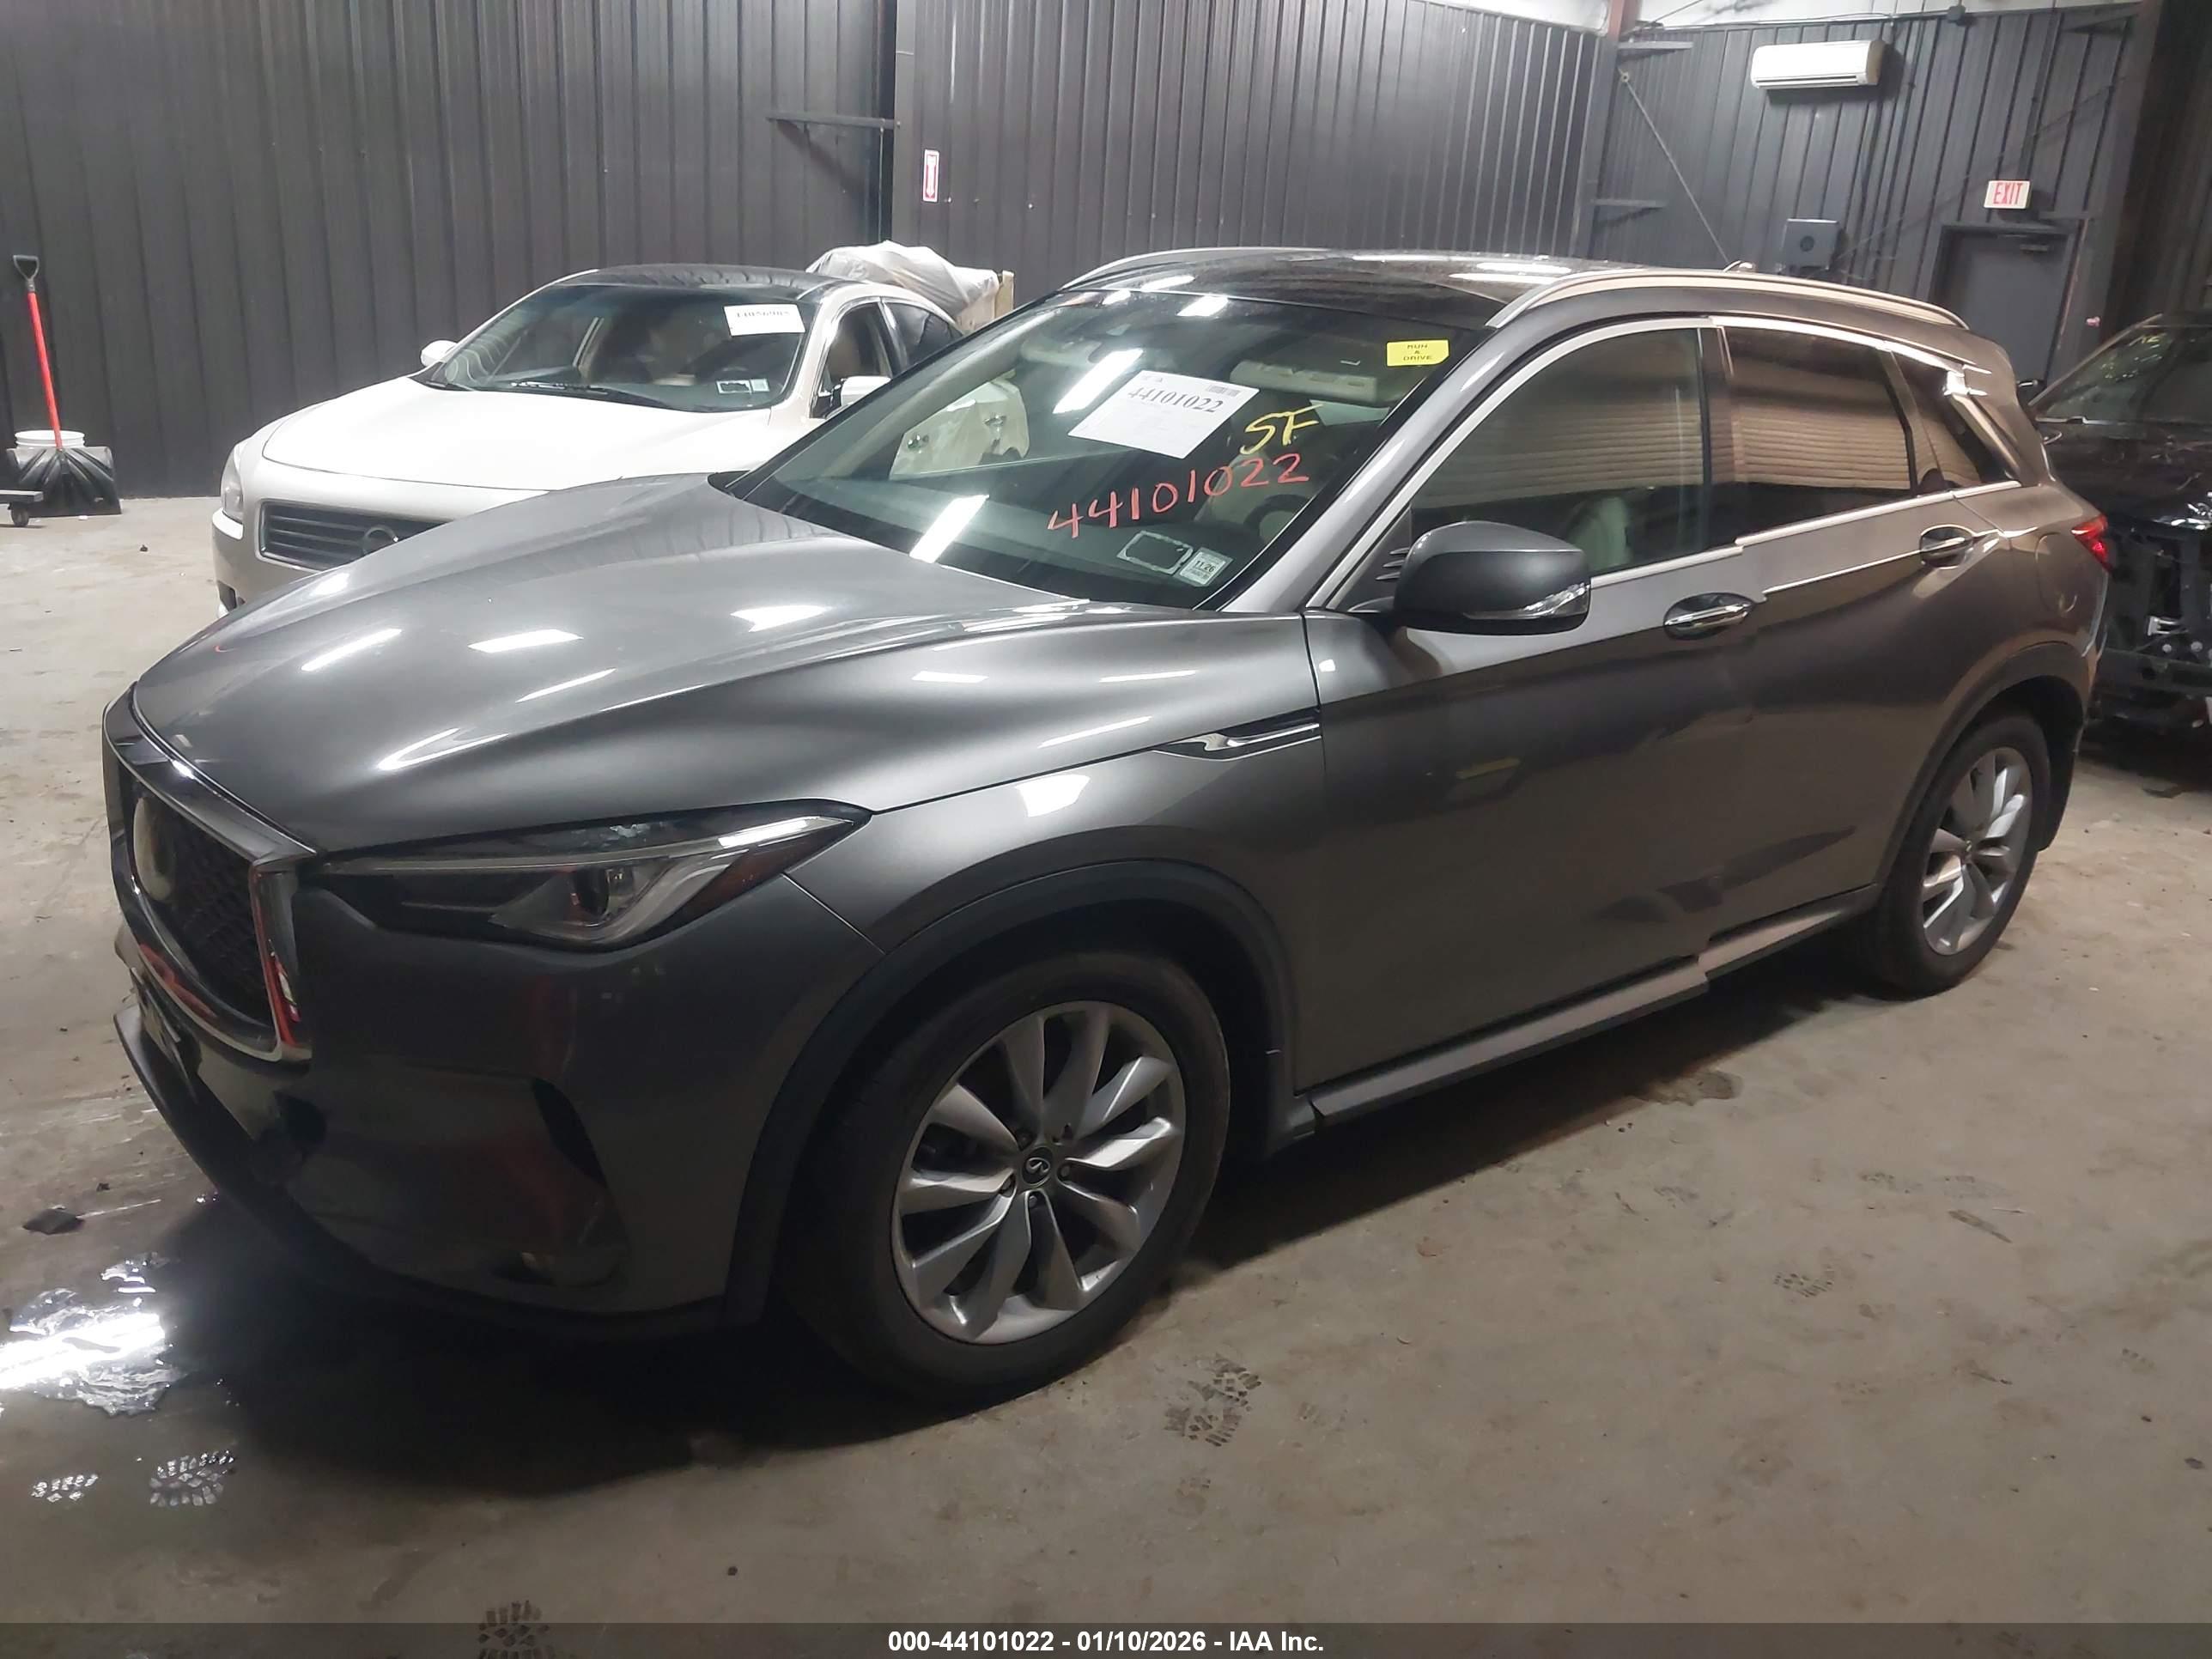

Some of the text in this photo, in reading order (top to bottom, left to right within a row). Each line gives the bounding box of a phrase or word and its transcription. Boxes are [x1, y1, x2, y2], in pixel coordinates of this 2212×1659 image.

[1992, 181, 2024, 205] EXIT
[1128, 387, 1224, 413] 44101022
[1239, 403, 1323, 455] SF
[1047, 453, 1310, 539] 44101022
